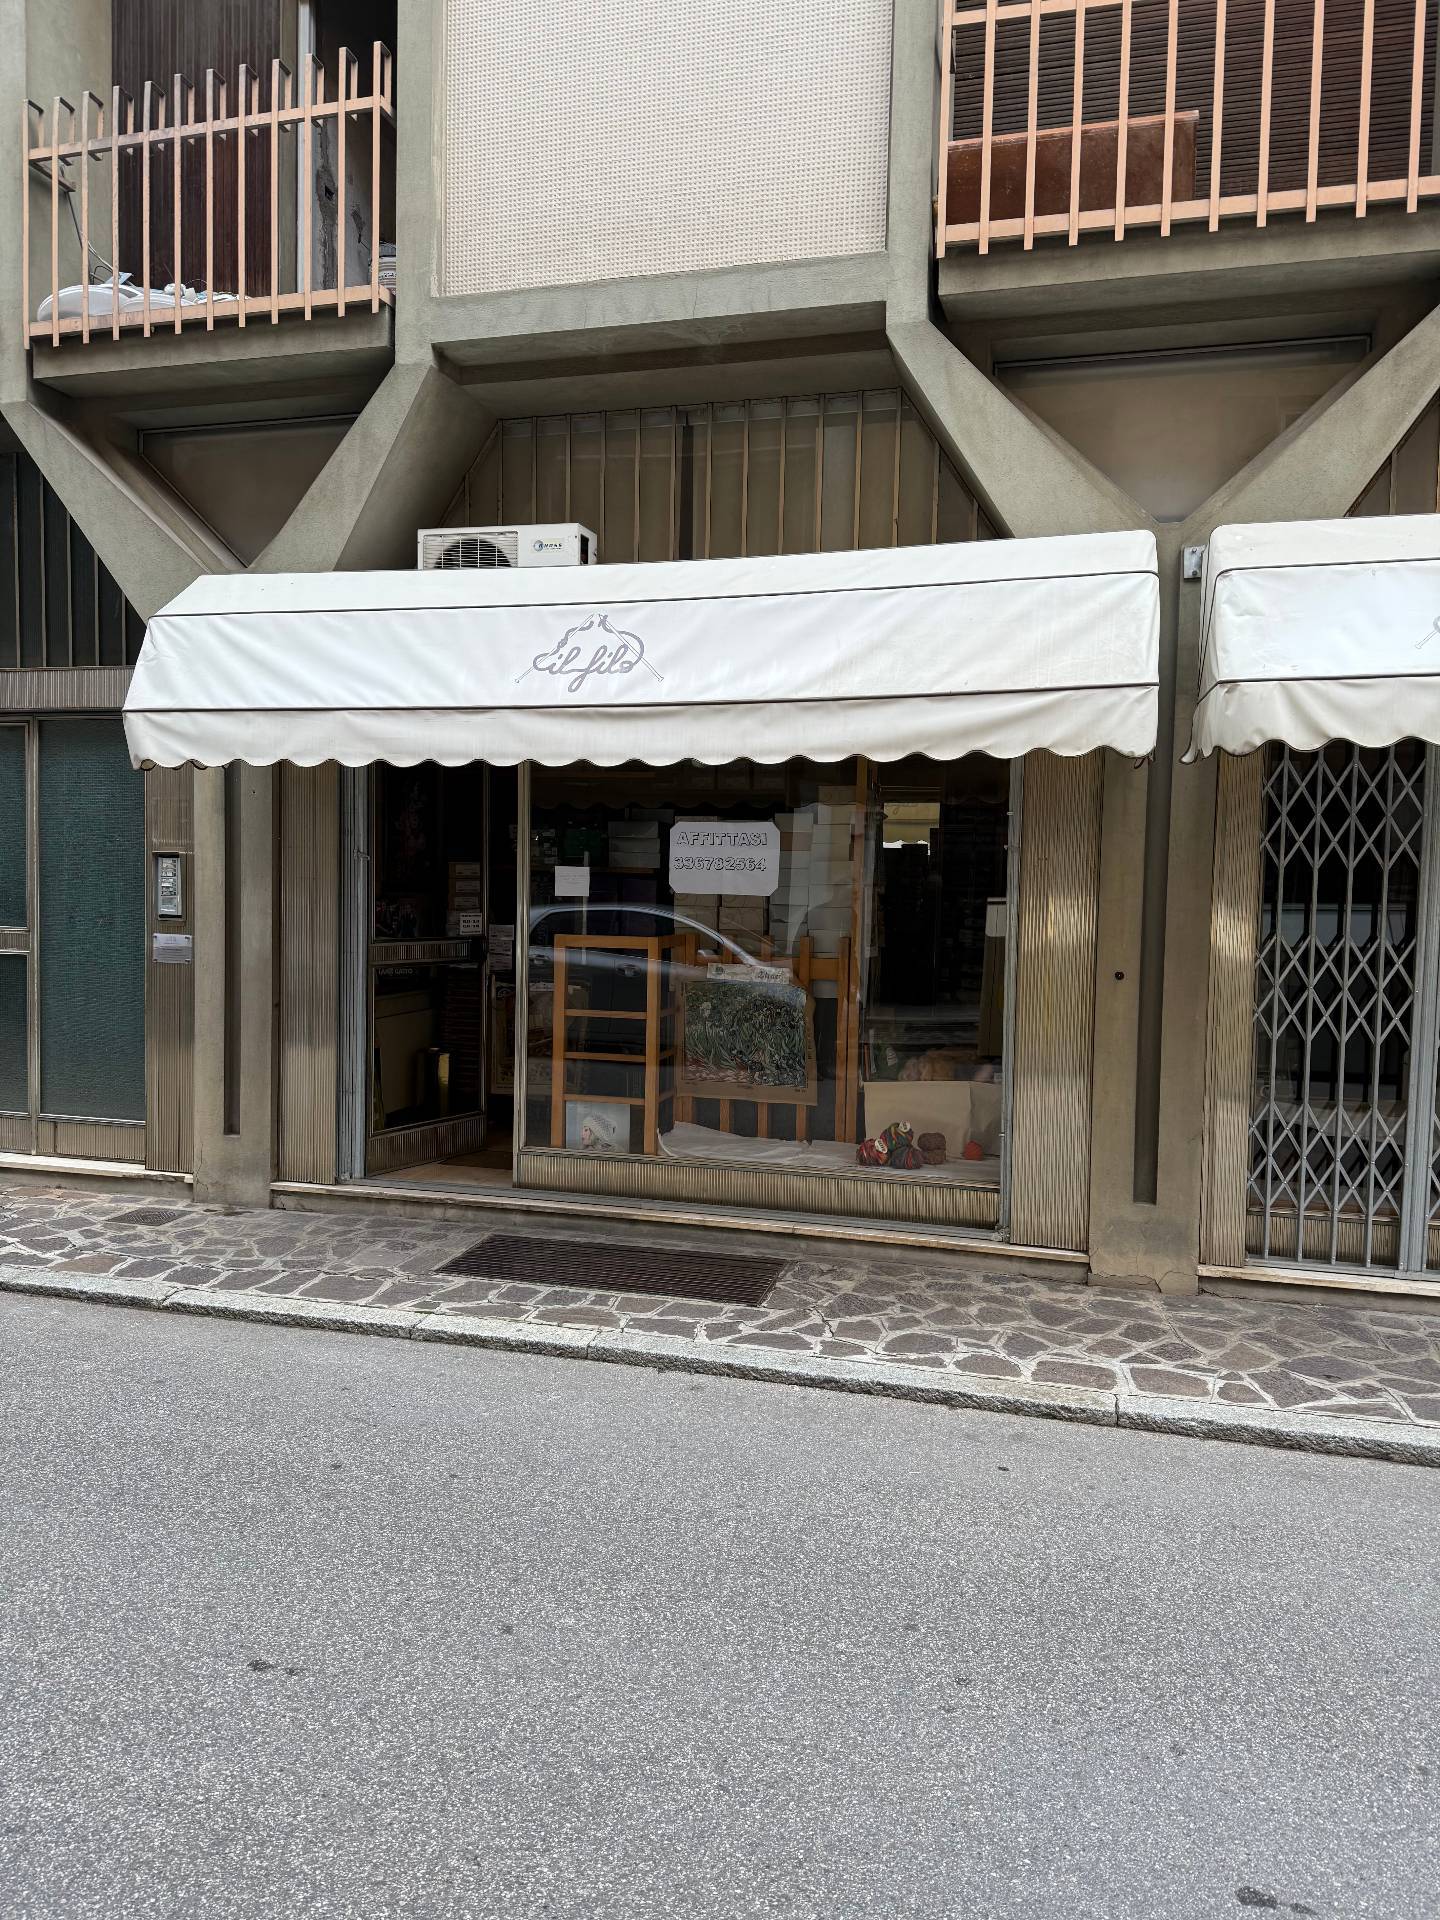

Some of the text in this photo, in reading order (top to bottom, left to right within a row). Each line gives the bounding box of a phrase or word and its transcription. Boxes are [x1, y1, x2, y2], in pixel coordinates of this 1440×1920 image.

[547, 644, 634, 693] il filo
[676, 831, 768, 847] AFFITTASI
[674, 856, 767, 872] 336782564
